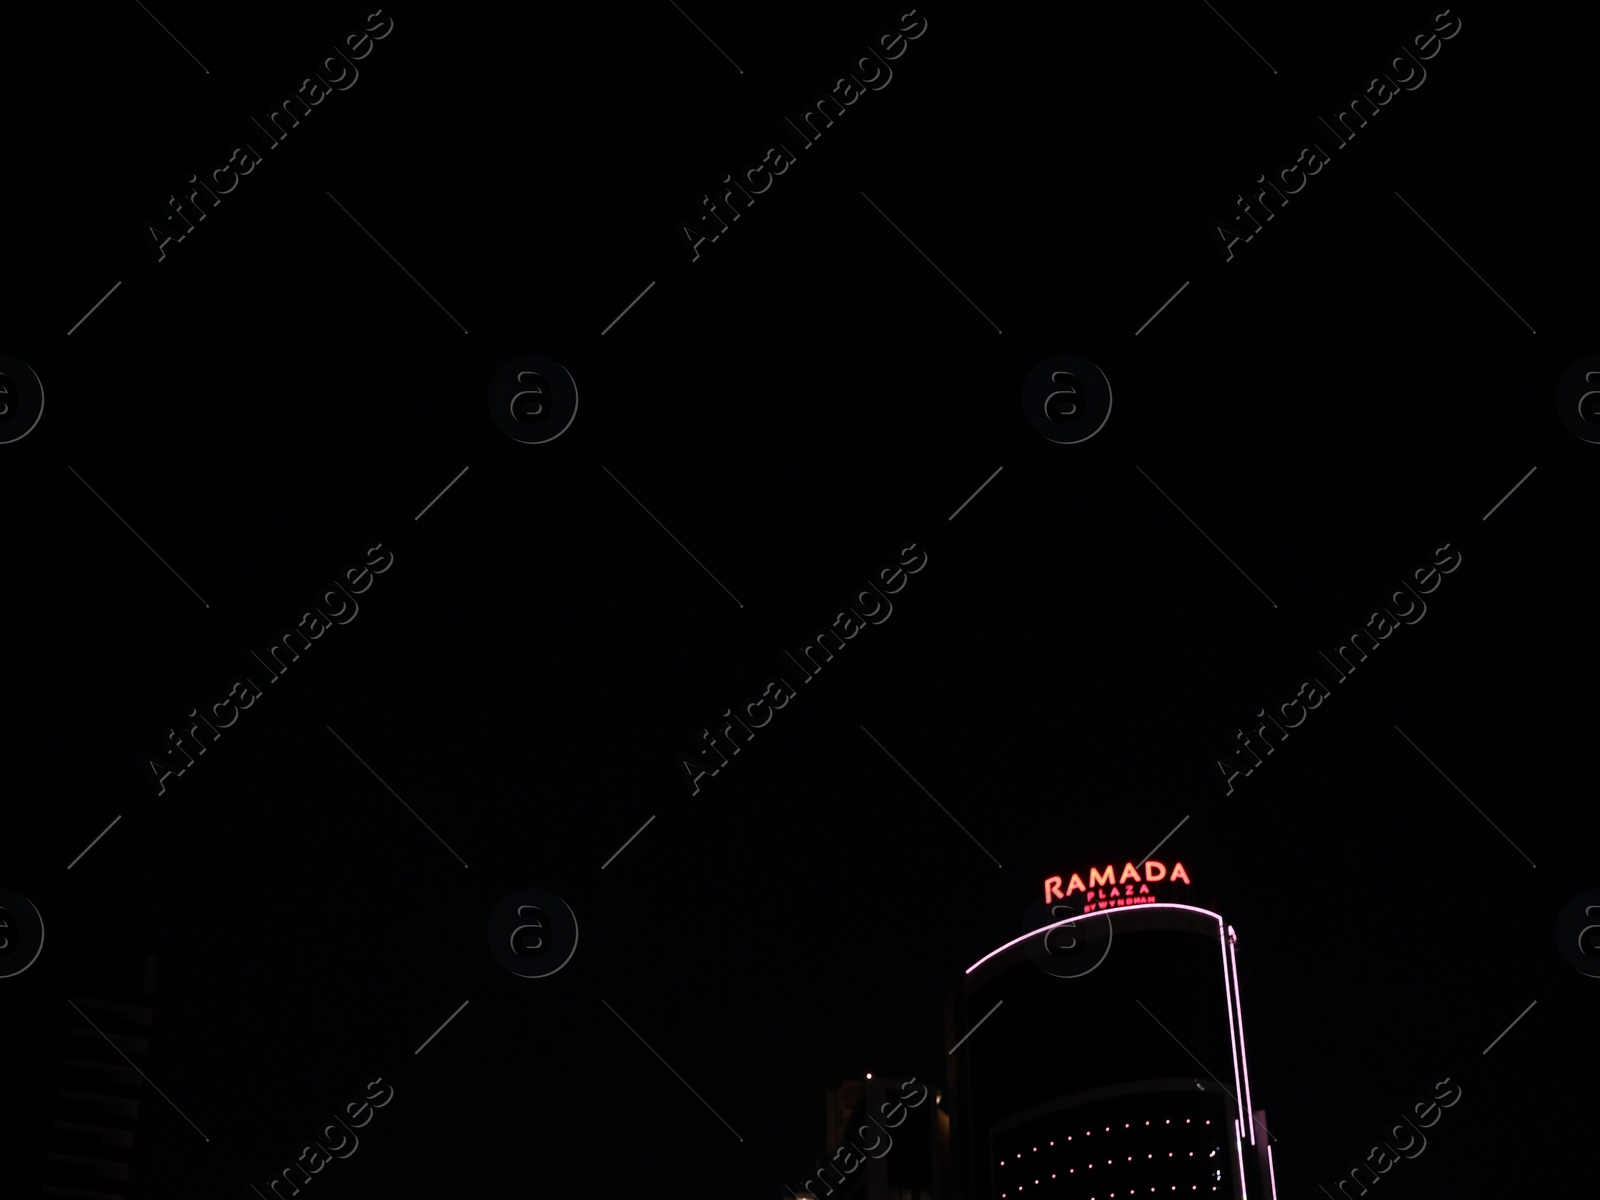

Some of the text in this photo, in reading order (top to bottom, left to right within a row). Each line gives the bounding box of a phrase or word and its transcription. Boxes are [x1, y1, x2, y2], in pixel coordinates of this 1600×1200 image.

[1044, 861, 1190, 904] RAMADA
[1087, 884, 1150, 902] PLAZA
[1098, 896, 1156, 909] WYNDHAM
